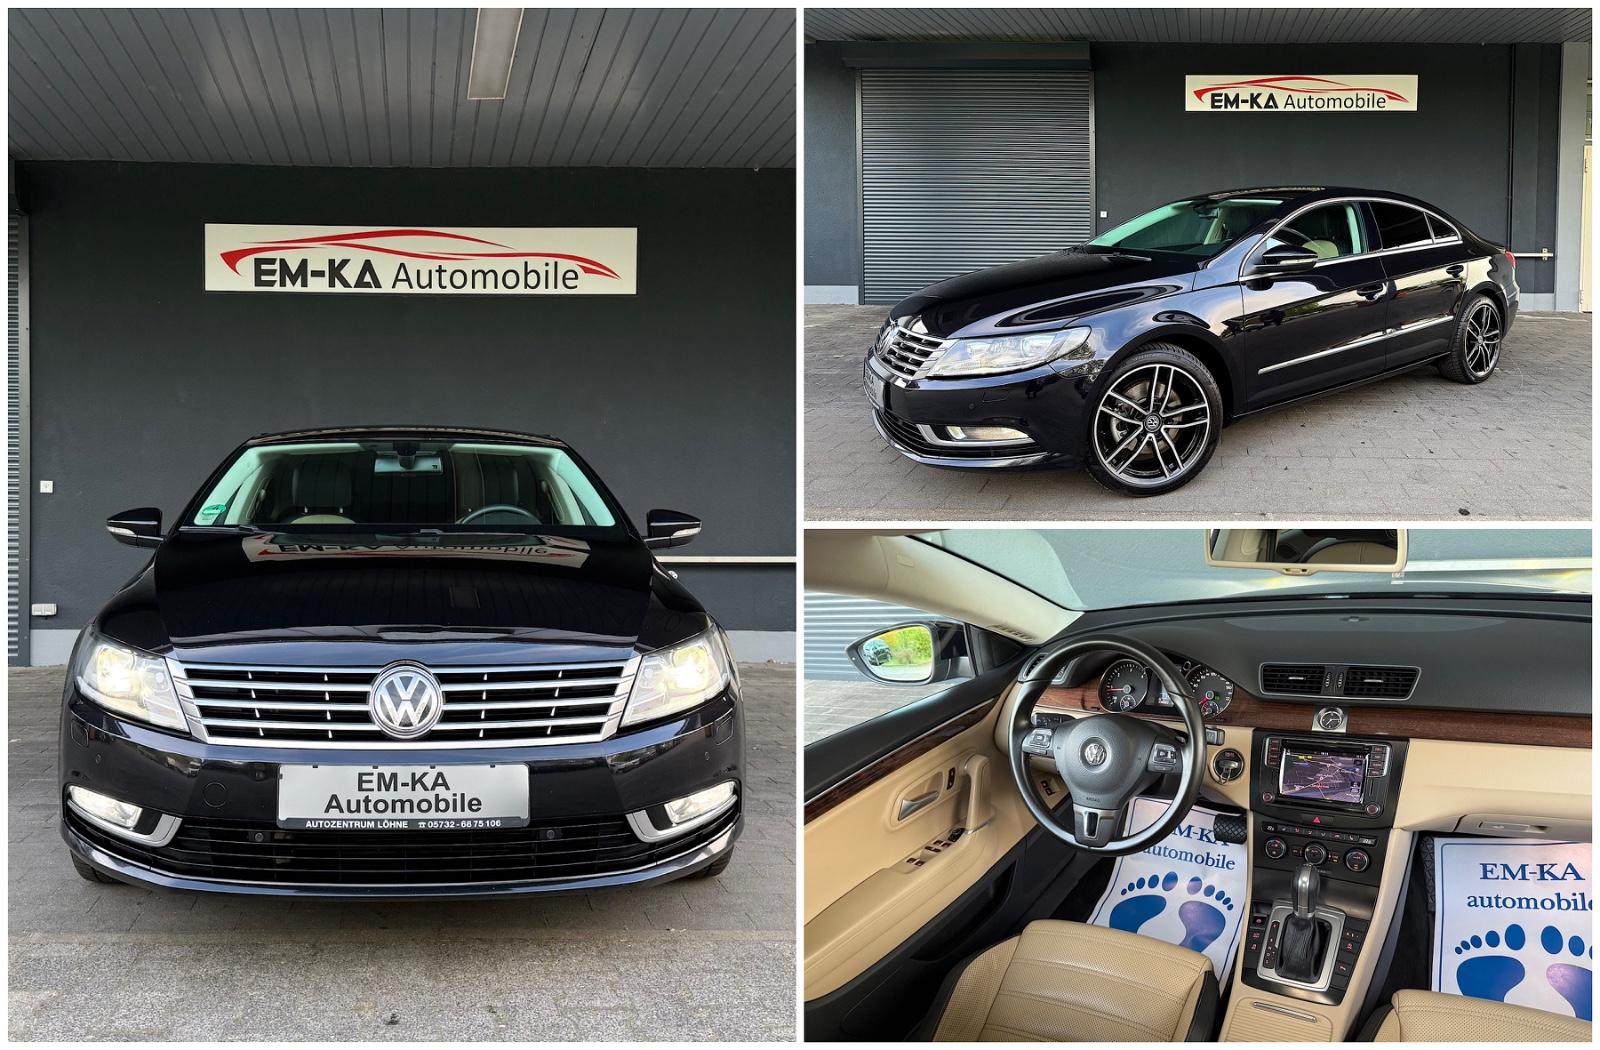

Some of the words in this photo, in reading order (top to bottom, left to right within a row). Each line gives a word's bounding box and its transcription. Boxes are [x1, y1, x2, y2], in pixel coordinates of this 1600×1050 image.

[1210, 92, 1279, 109] EM-KA
[1283, 93, 1386, 109] Automobile
[253, 257, 382, 289] EM-KA
[392, 260, 579, 290] Automobile
[357, 771, 450, 792] EM-KA
[324, 793, 482, 814] Automobile
[305, 820, 375, 828] AUTOZENTRUM
[377, 819, 408, 828] LÖHNE
[1479, 862, 1585, 881] EM-KA
